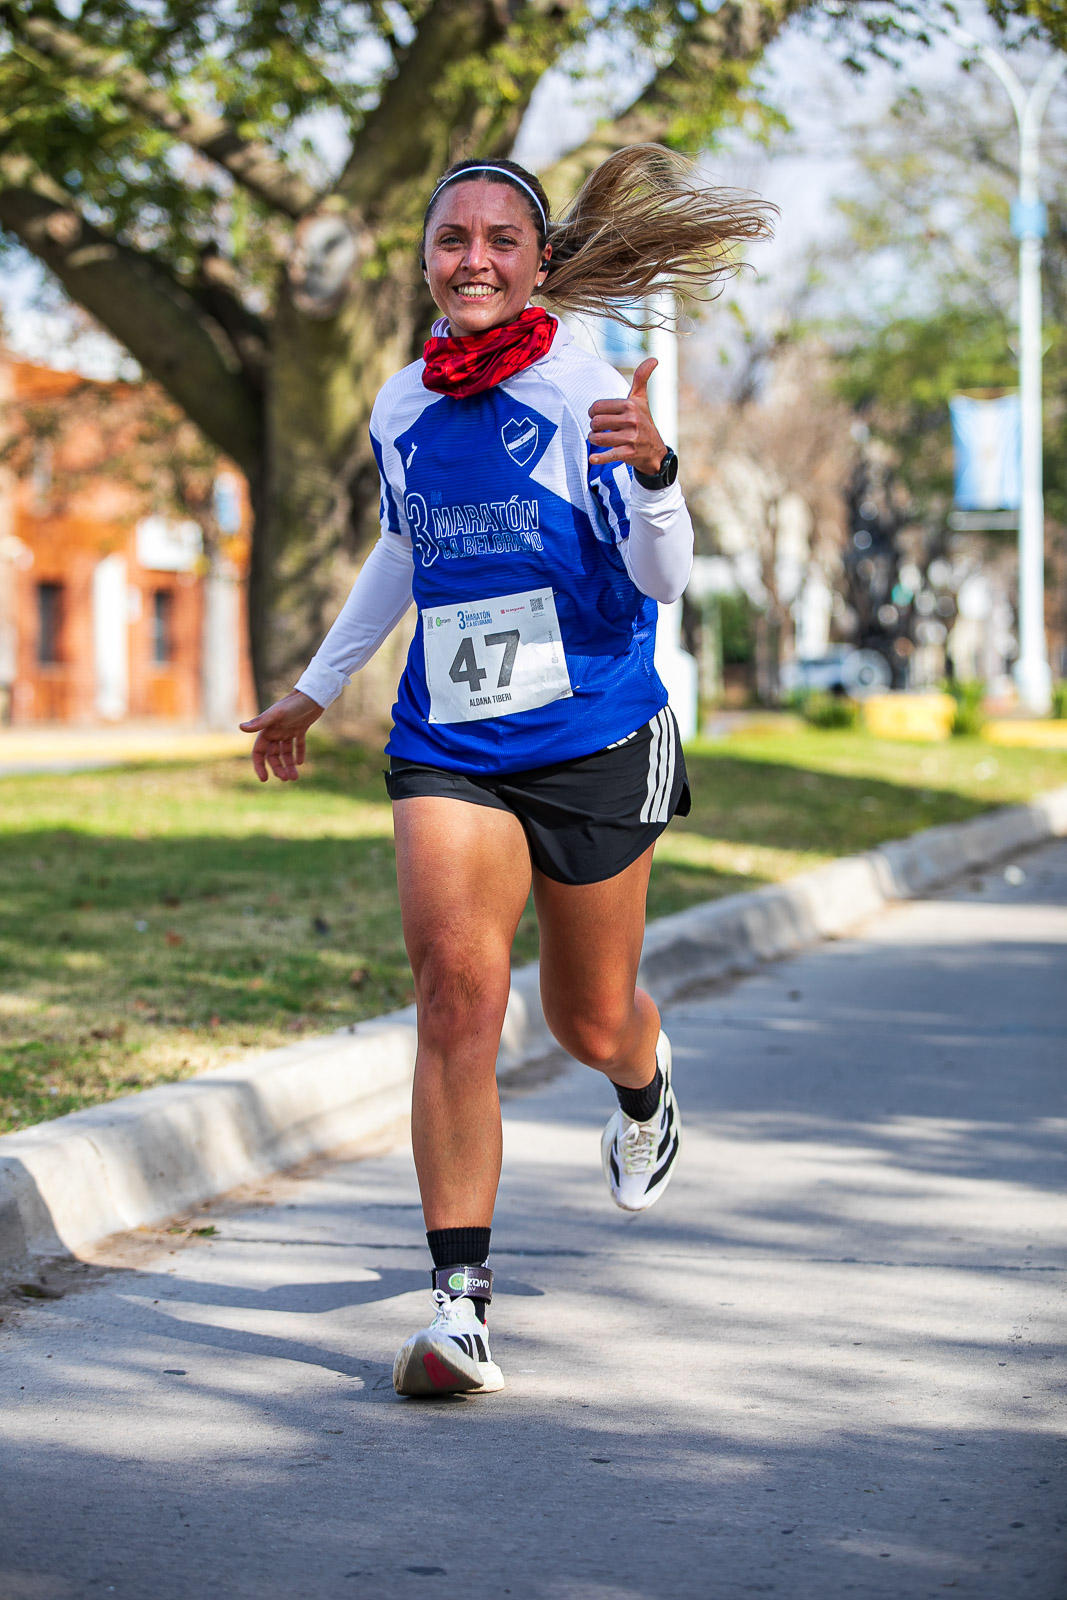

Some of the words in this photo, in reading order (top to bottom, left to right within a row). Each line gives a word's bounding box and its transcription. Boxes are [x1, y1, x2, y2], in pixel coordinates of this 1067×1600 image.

[406, 492, 439, 567] 3
[431, 494, 540, 538] MARATÓN
[457, 610, 466, 630] 3
[465, 610, 491, 621] MARATÓN
[448, 629, 521, 692] 47
[469, 696, 492, 707] ALDANA
[492, 692, 512, 704] TIBERI
